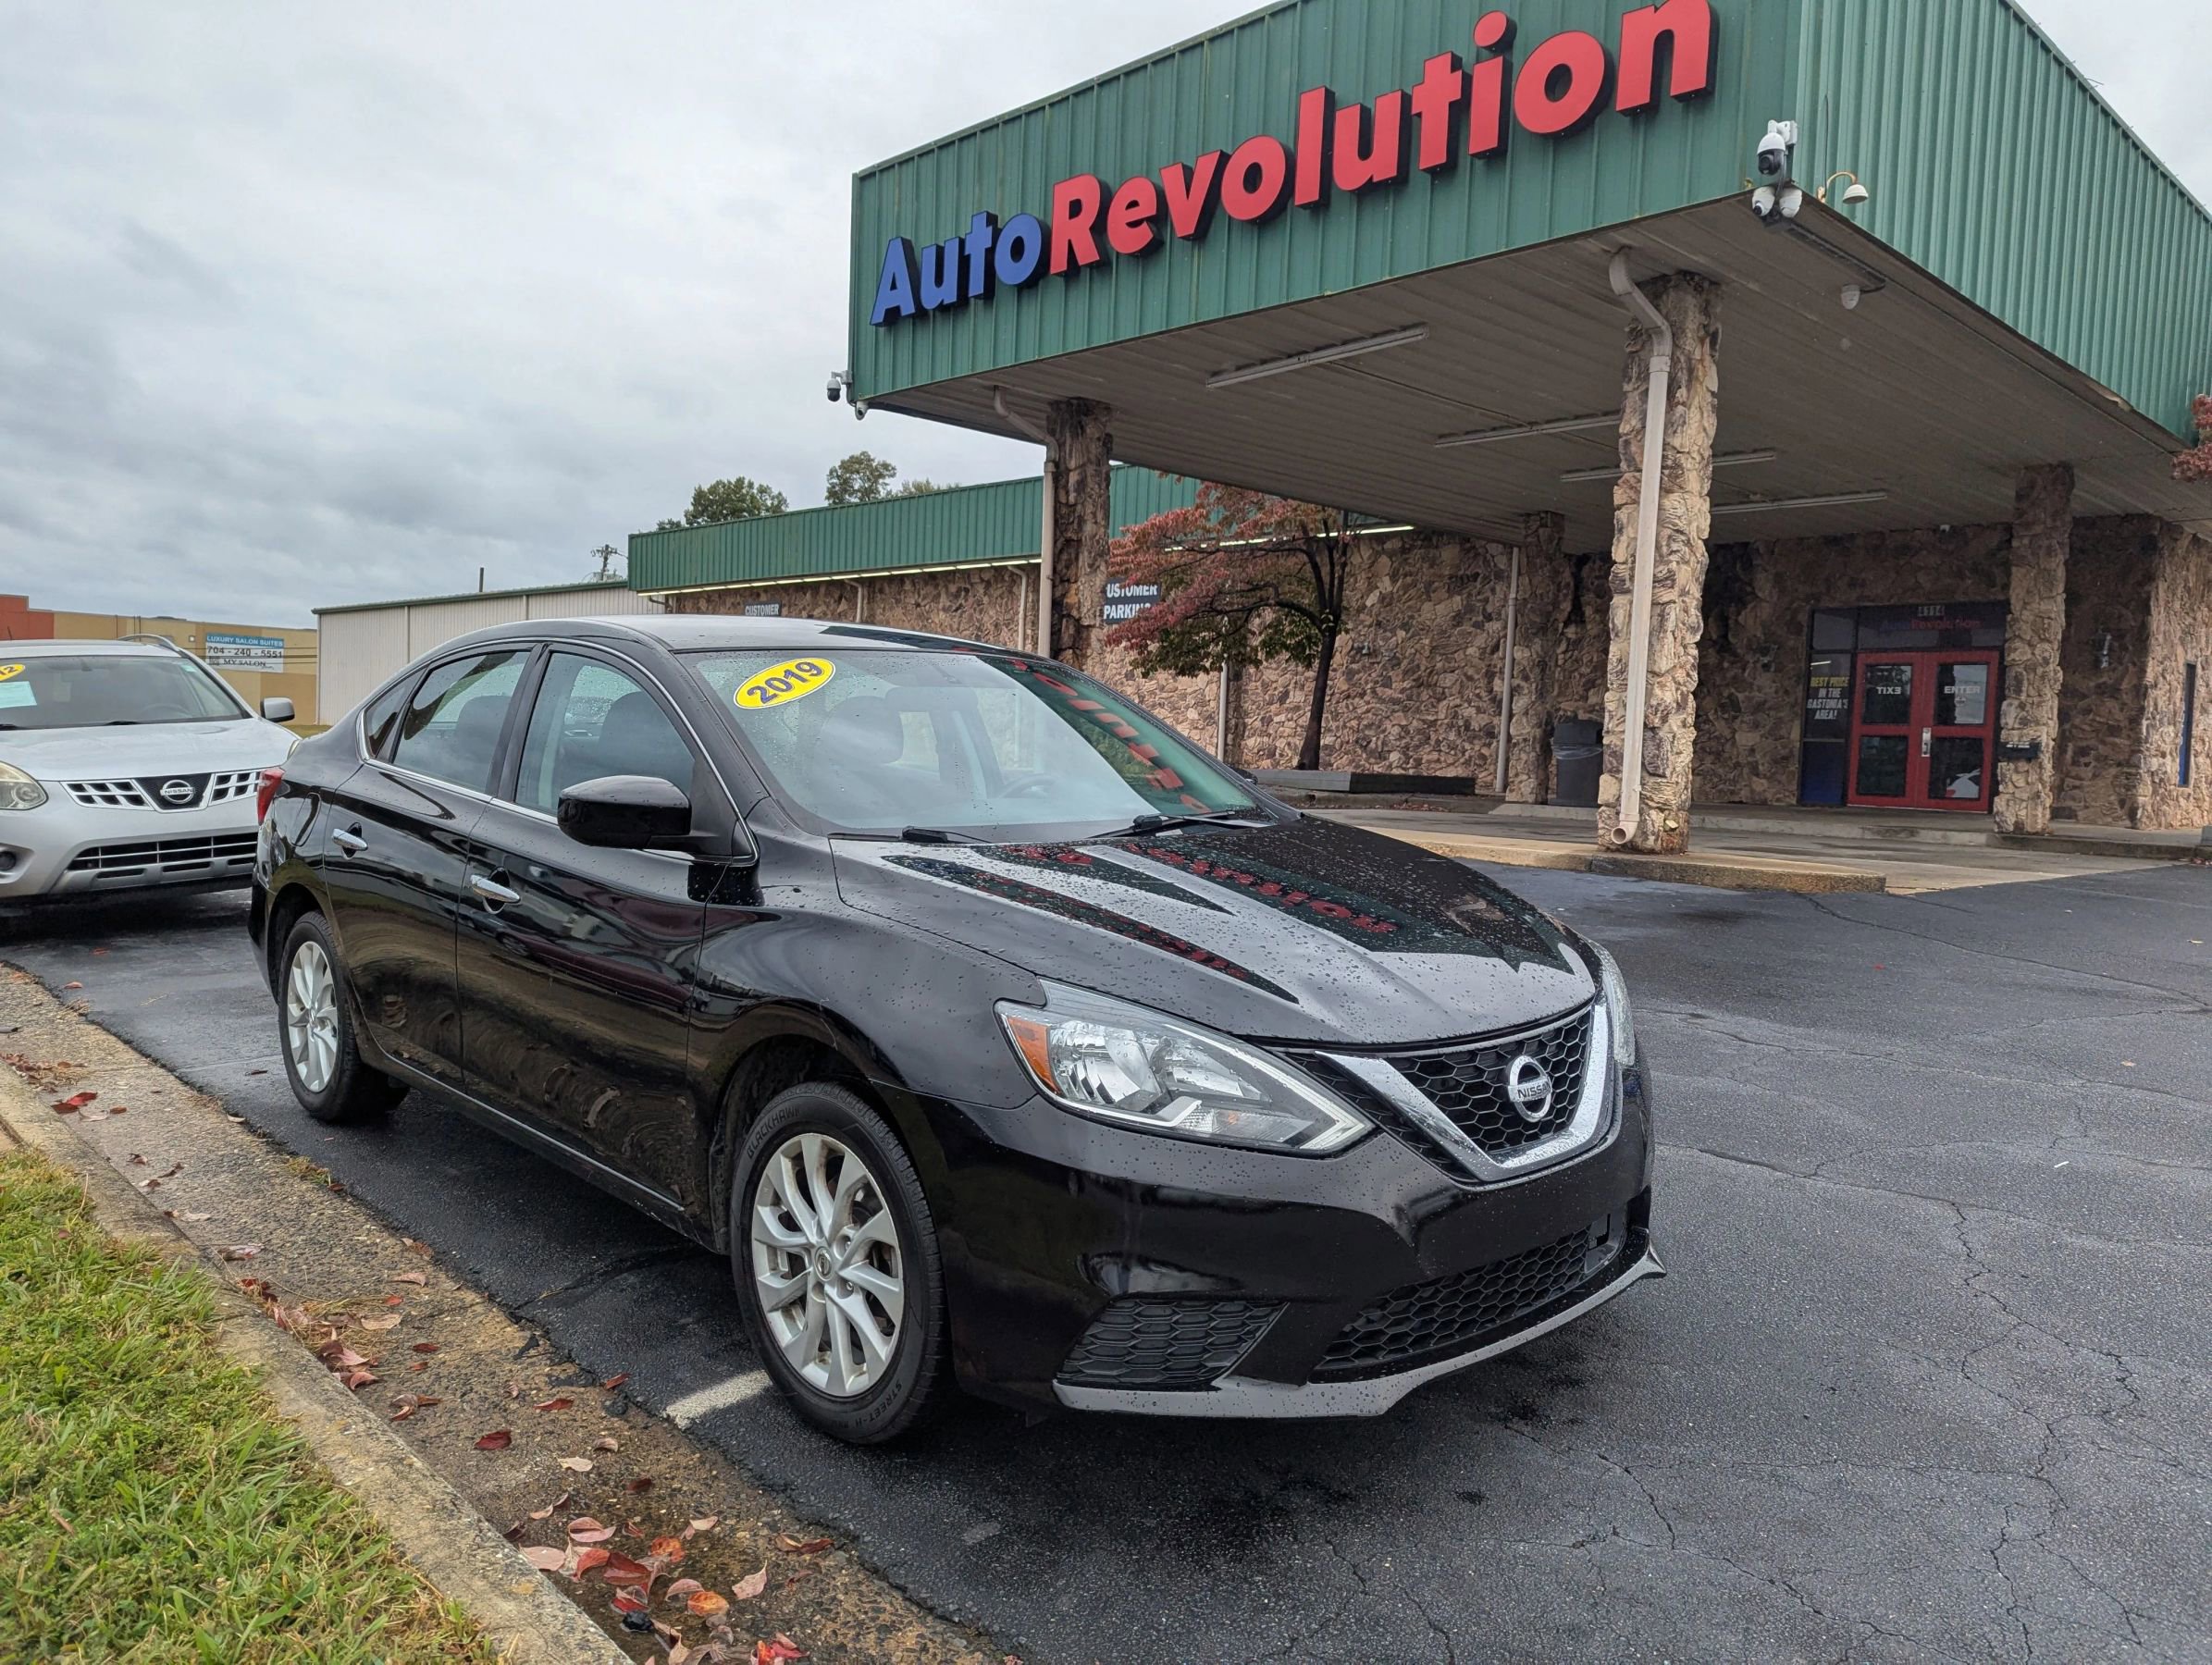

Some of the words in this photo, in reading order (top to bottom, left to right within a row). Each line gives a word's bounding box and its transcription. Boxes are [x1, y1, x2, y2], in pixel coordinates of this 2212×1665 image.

[1106, 583, 1158, 598] USTOMER
[745, 603, 779, 616] CUSTOMER
[235, 637, 259, 646] SALON
[259, 639, 283, 648] SUITES
[207, 646, 225, 654] 704
[234, 648, 252, 657] 240
[260, 650, 283, 659] 5551
[747, 661, 823, 704] 2019
[1809, 676, 1829, 687] BEST
[1828, 687, 1843, 698] THE
[1944, 685, 1981, 695] ENTER
